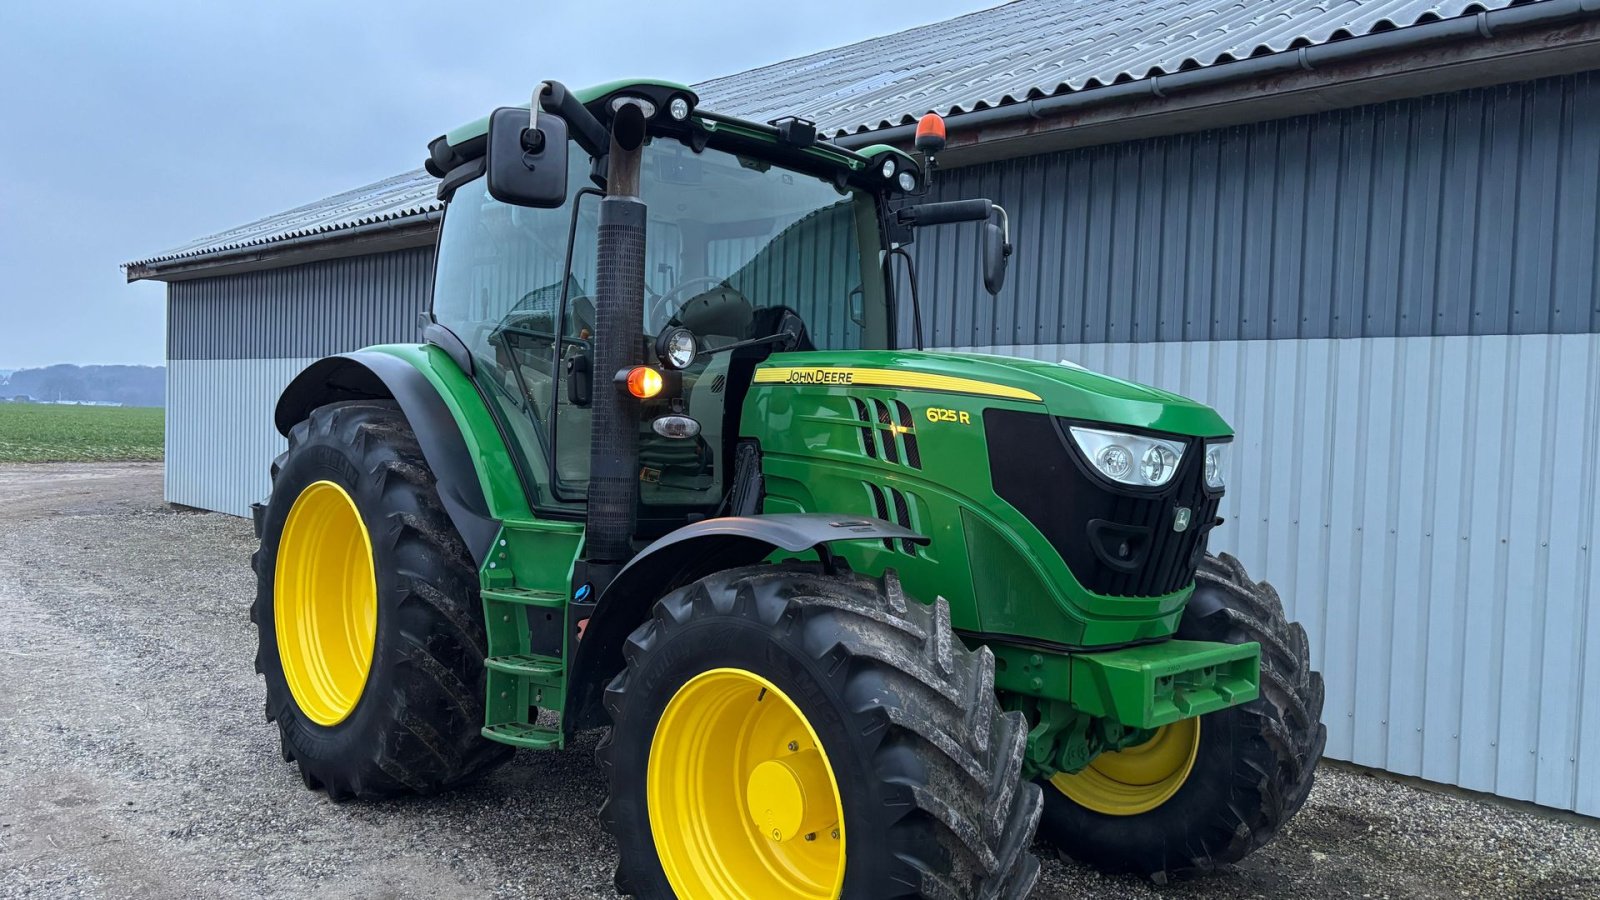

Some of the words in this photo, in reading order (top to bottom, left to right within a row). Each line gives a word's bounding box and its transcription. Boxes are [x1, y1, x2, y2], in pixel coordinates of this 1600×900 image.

[786, 369, 814, 382] JOHN
[815, 369, 853, 383] DEERE
[926, 407, 957, 423] 6125
[958, 410, 971, 425] R
